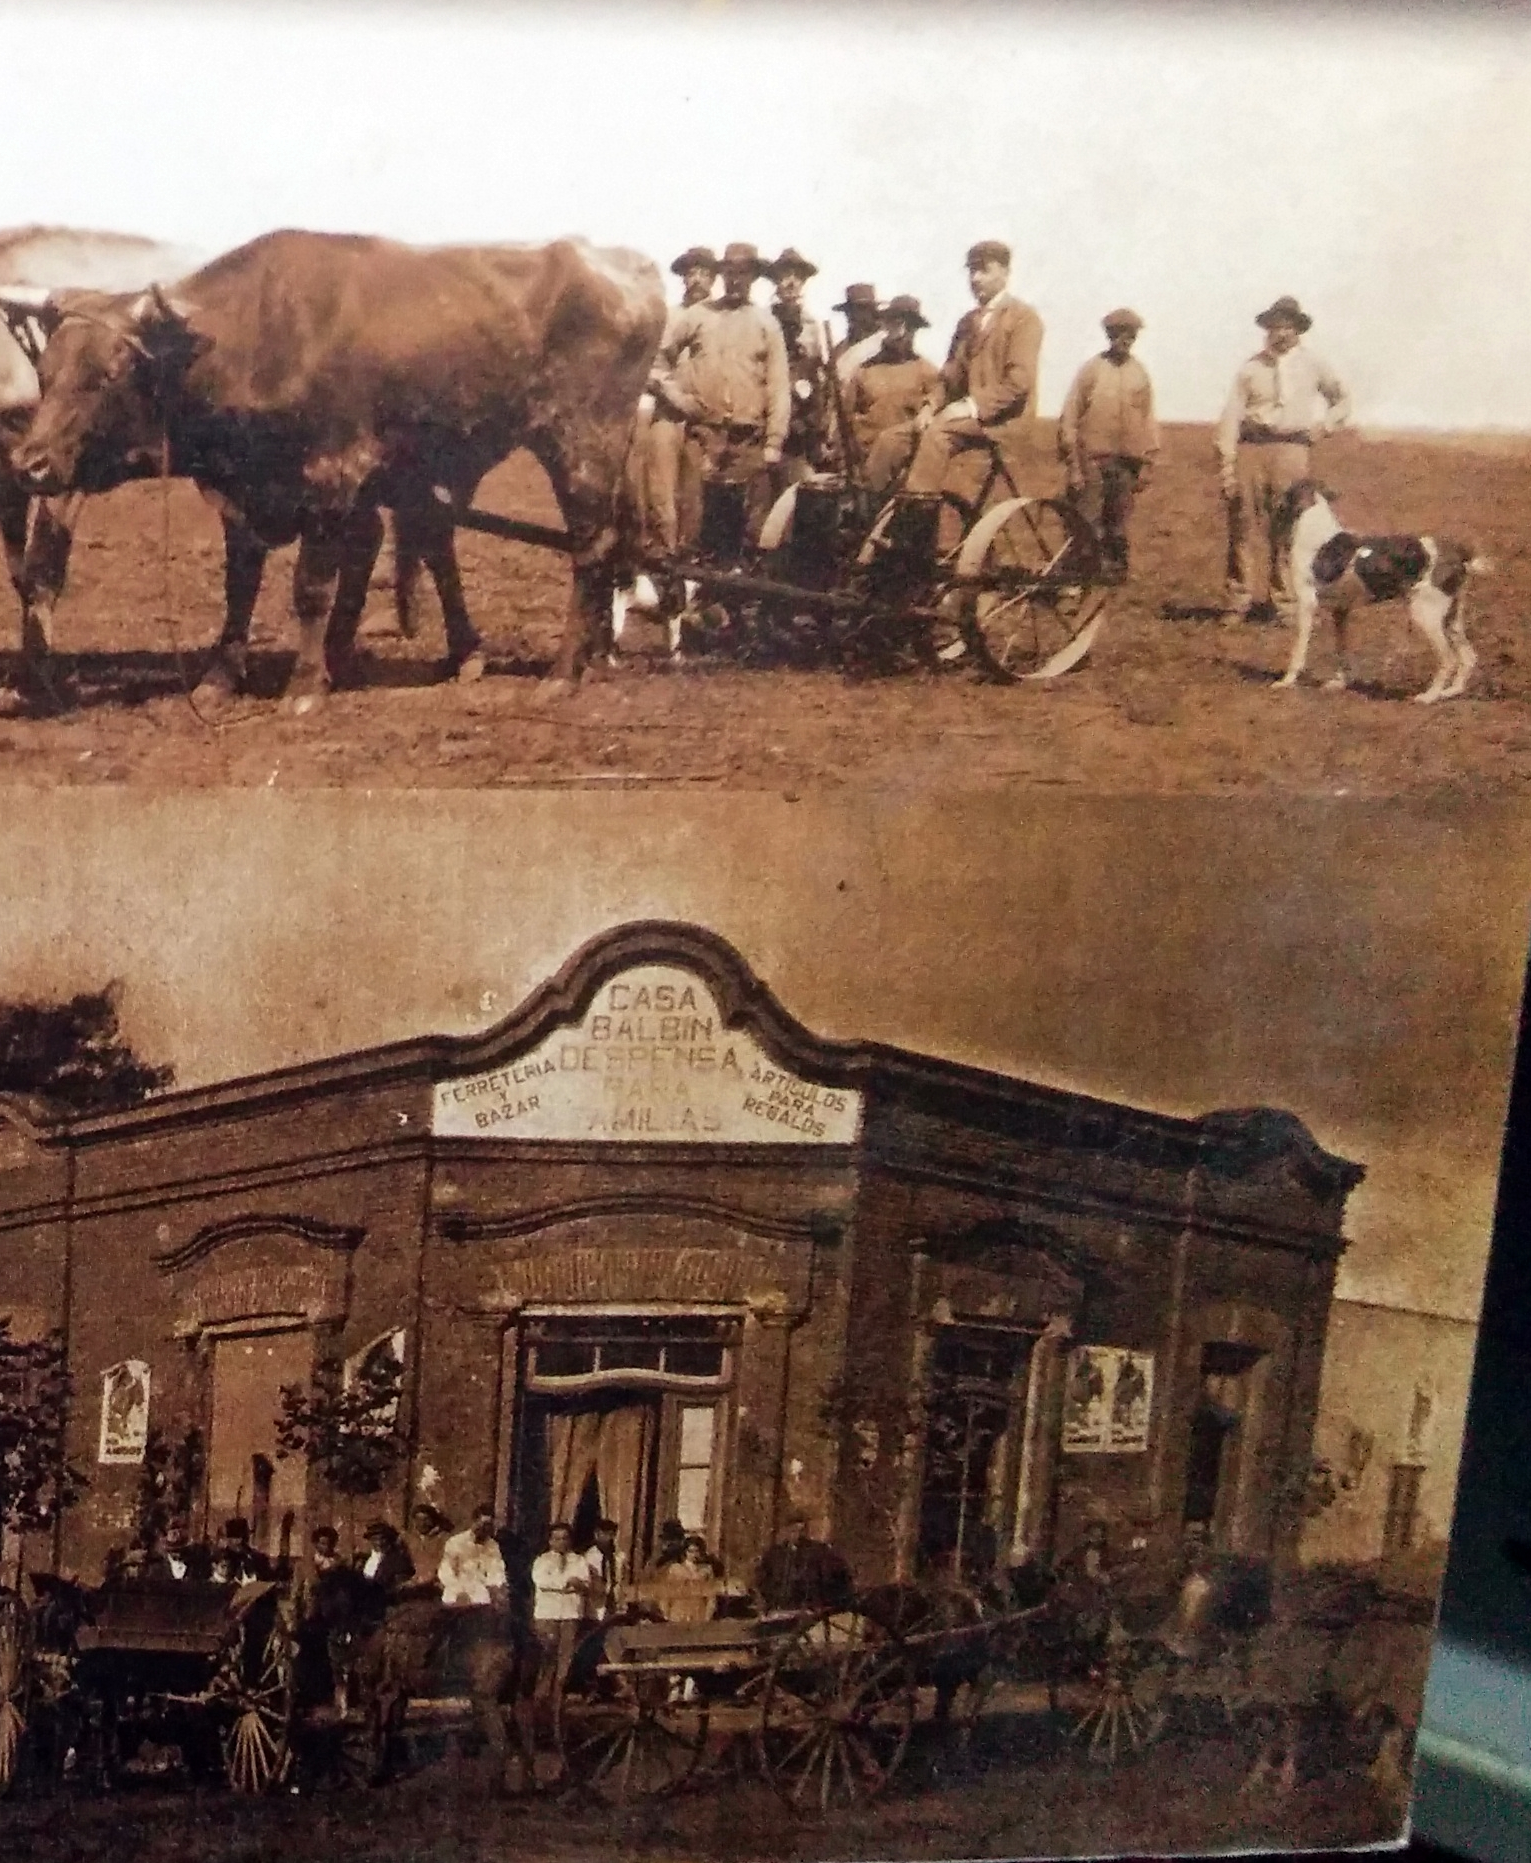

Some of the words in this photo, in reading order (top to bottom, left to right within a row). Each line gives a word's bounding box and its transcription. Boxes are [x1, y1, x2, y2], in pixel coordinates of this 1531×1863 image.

[609, 984, 697, 1011] CASA
[592, 1015, 714, 1042] BALBIN
[560, 1046, 739, 1071] DESPENSA
[750, 1061, 848, 1113] ARTICULOS
[475, 1095, 541, 1129] BAZAR
[769, 1090, 815, 1116] PARA
[742, 1097, 826, 1137] REGALOS
